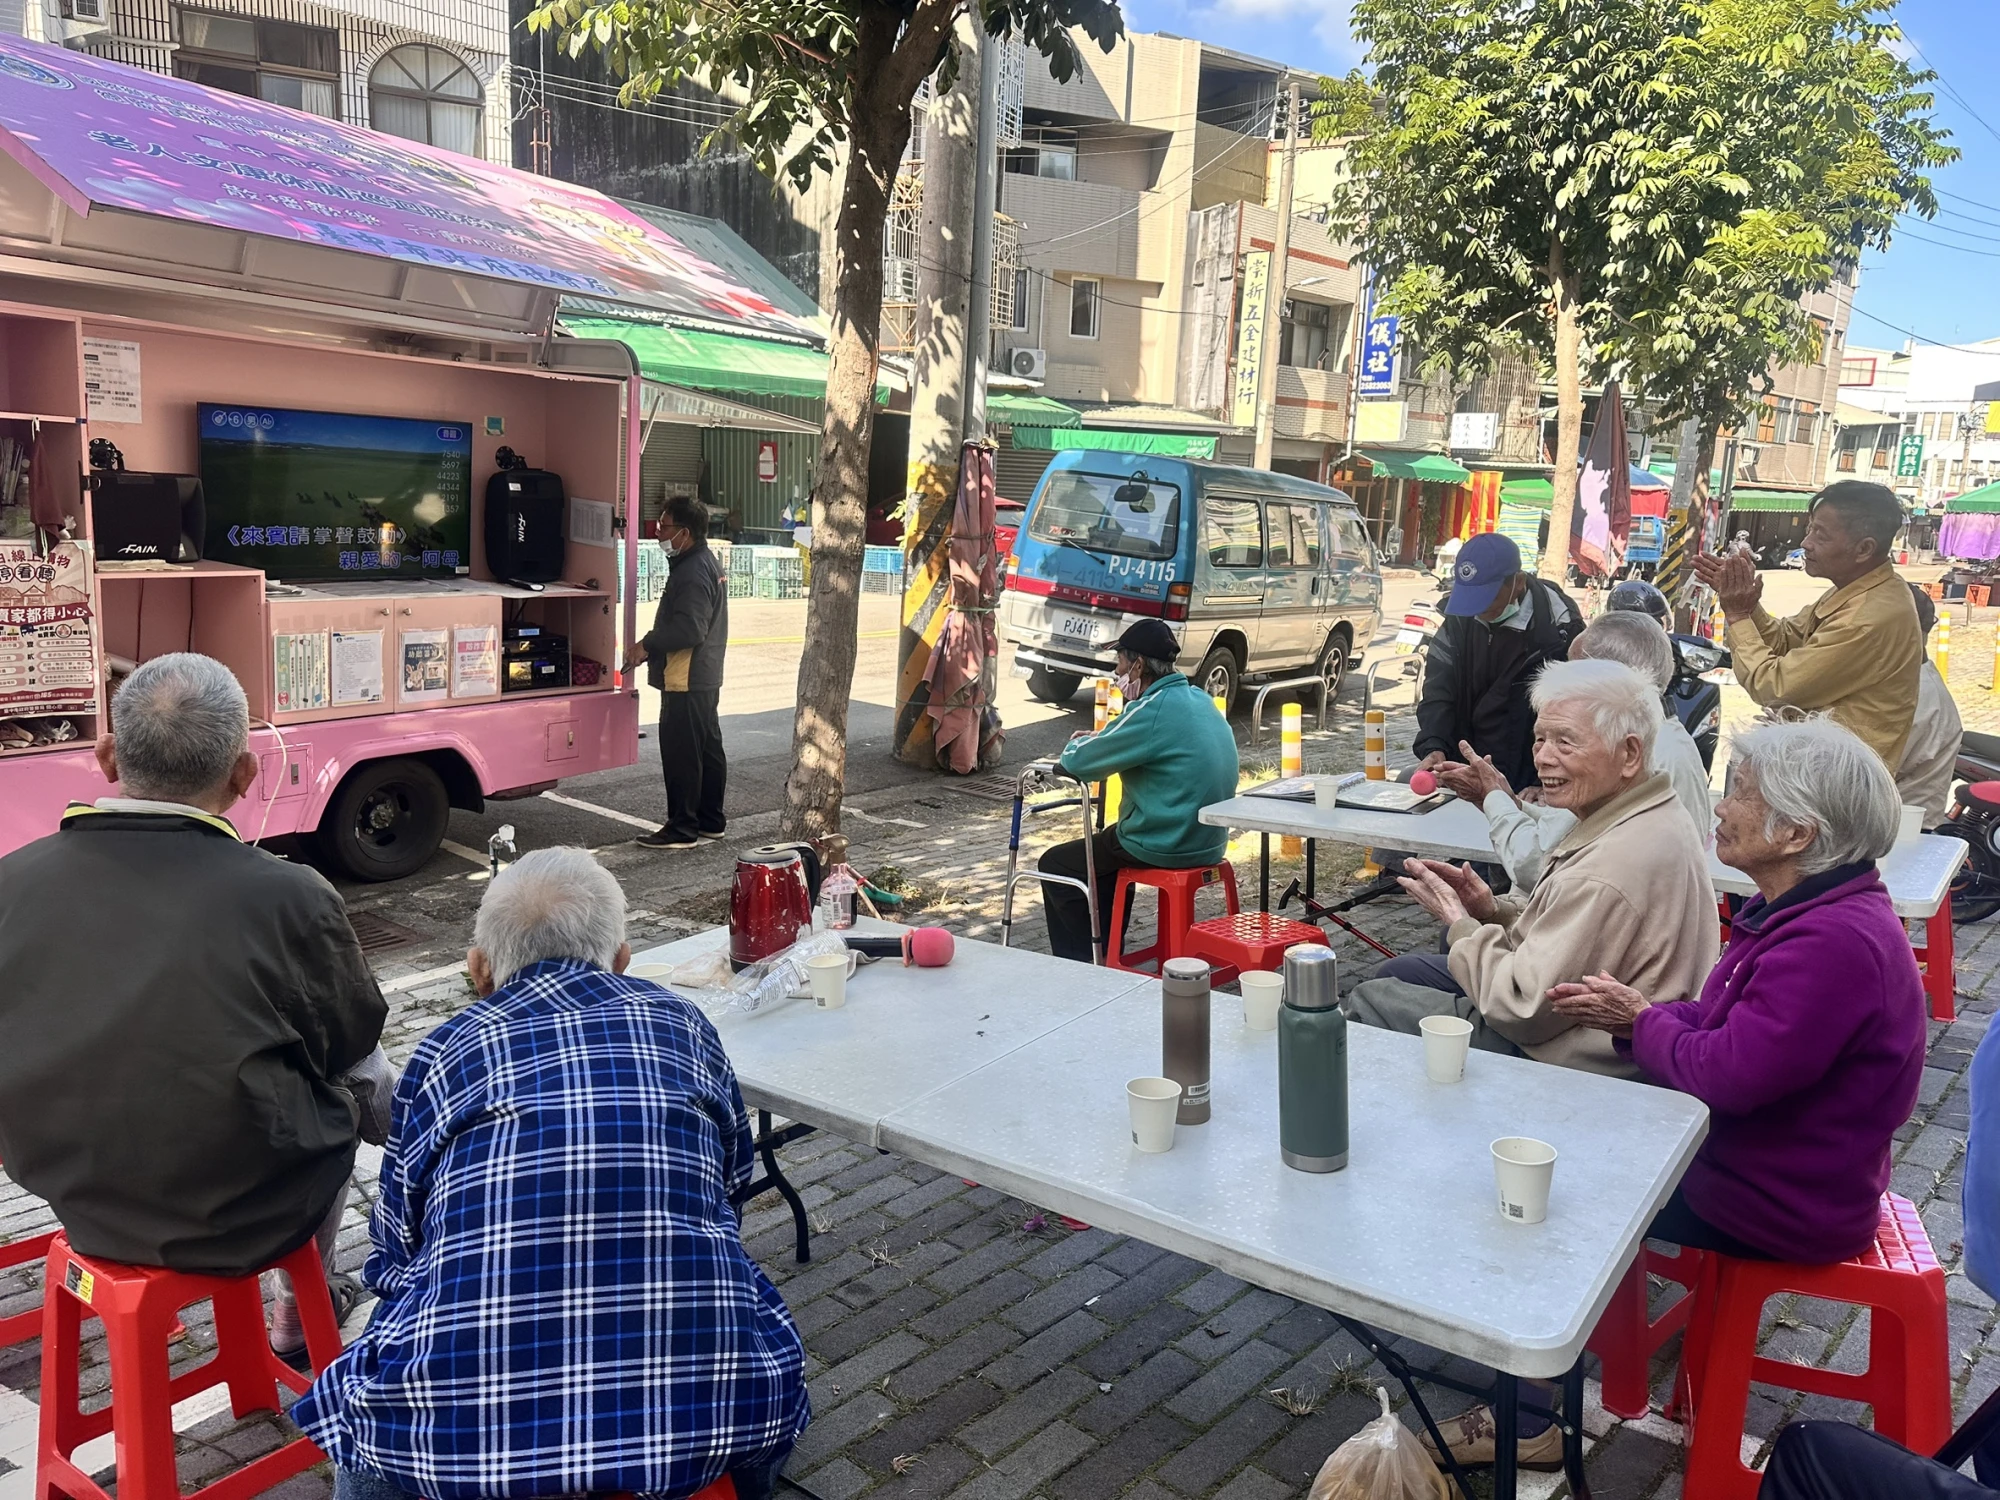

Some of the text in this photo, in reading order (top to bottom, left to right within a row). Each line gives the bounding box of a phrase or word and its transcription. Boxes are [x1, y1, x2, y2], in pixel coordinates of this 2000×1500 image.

[313, 222, 619, 297] 臺中市政府社會局
[441, 461, 460, 470] 5697
[437, 472, 460, 480] 44223
[118, 544, 158, 555] FAIN
[1109, 555, 1176, 582] PJ-4115
[1050, 585, 1119, 603] DELICA
[1064, 619, 1099, 638] PJ4115
